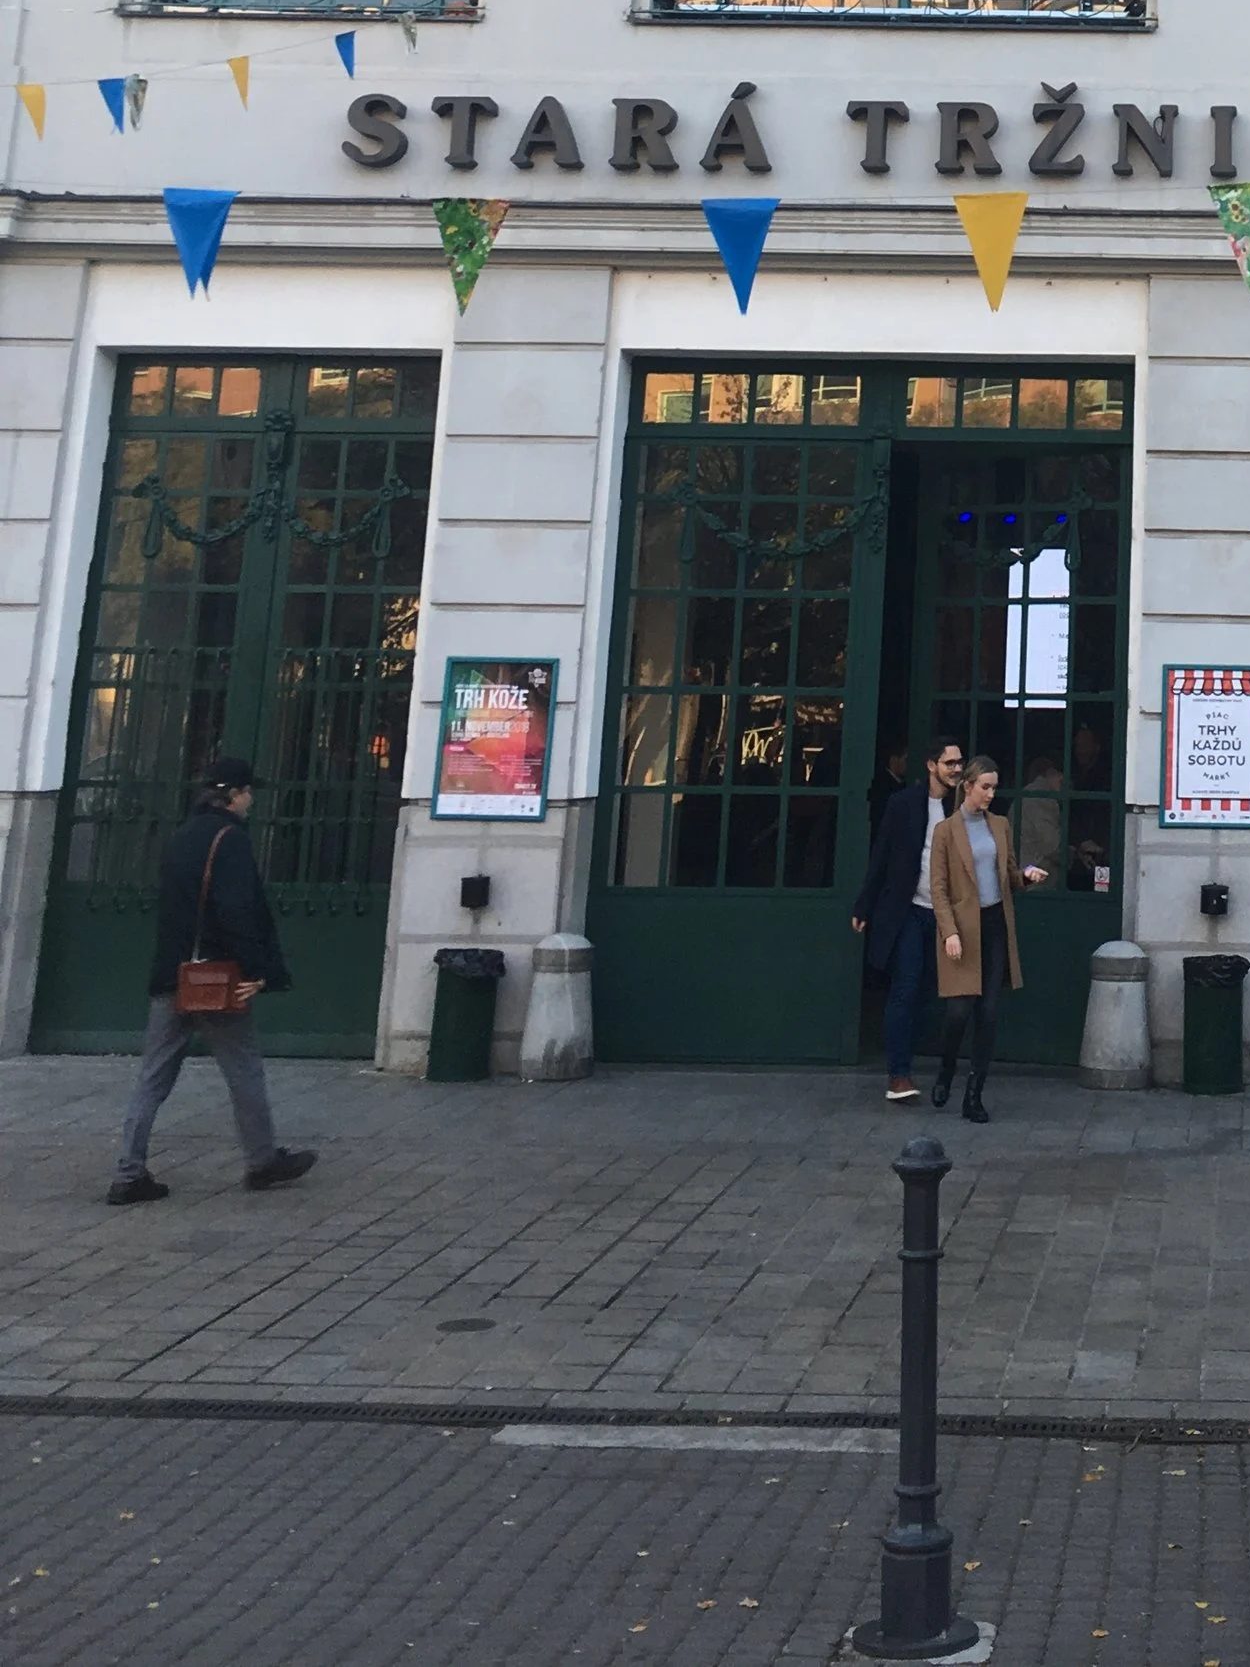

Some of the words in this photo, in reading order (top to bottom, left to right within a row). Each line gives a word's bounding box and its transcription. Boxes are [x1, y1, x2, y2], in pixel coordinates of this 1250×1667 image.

[339, 81, 772, 175] STARÁ
[455, 689, 485, 710] TRH
[487, 685, 529, 710] KOŽE
[1198, 725, 1237, 736] TRHY
[1193, 737, 1242, 751] KAŽDÚ
[1187, 754, 1246, 766] SOBOTU
